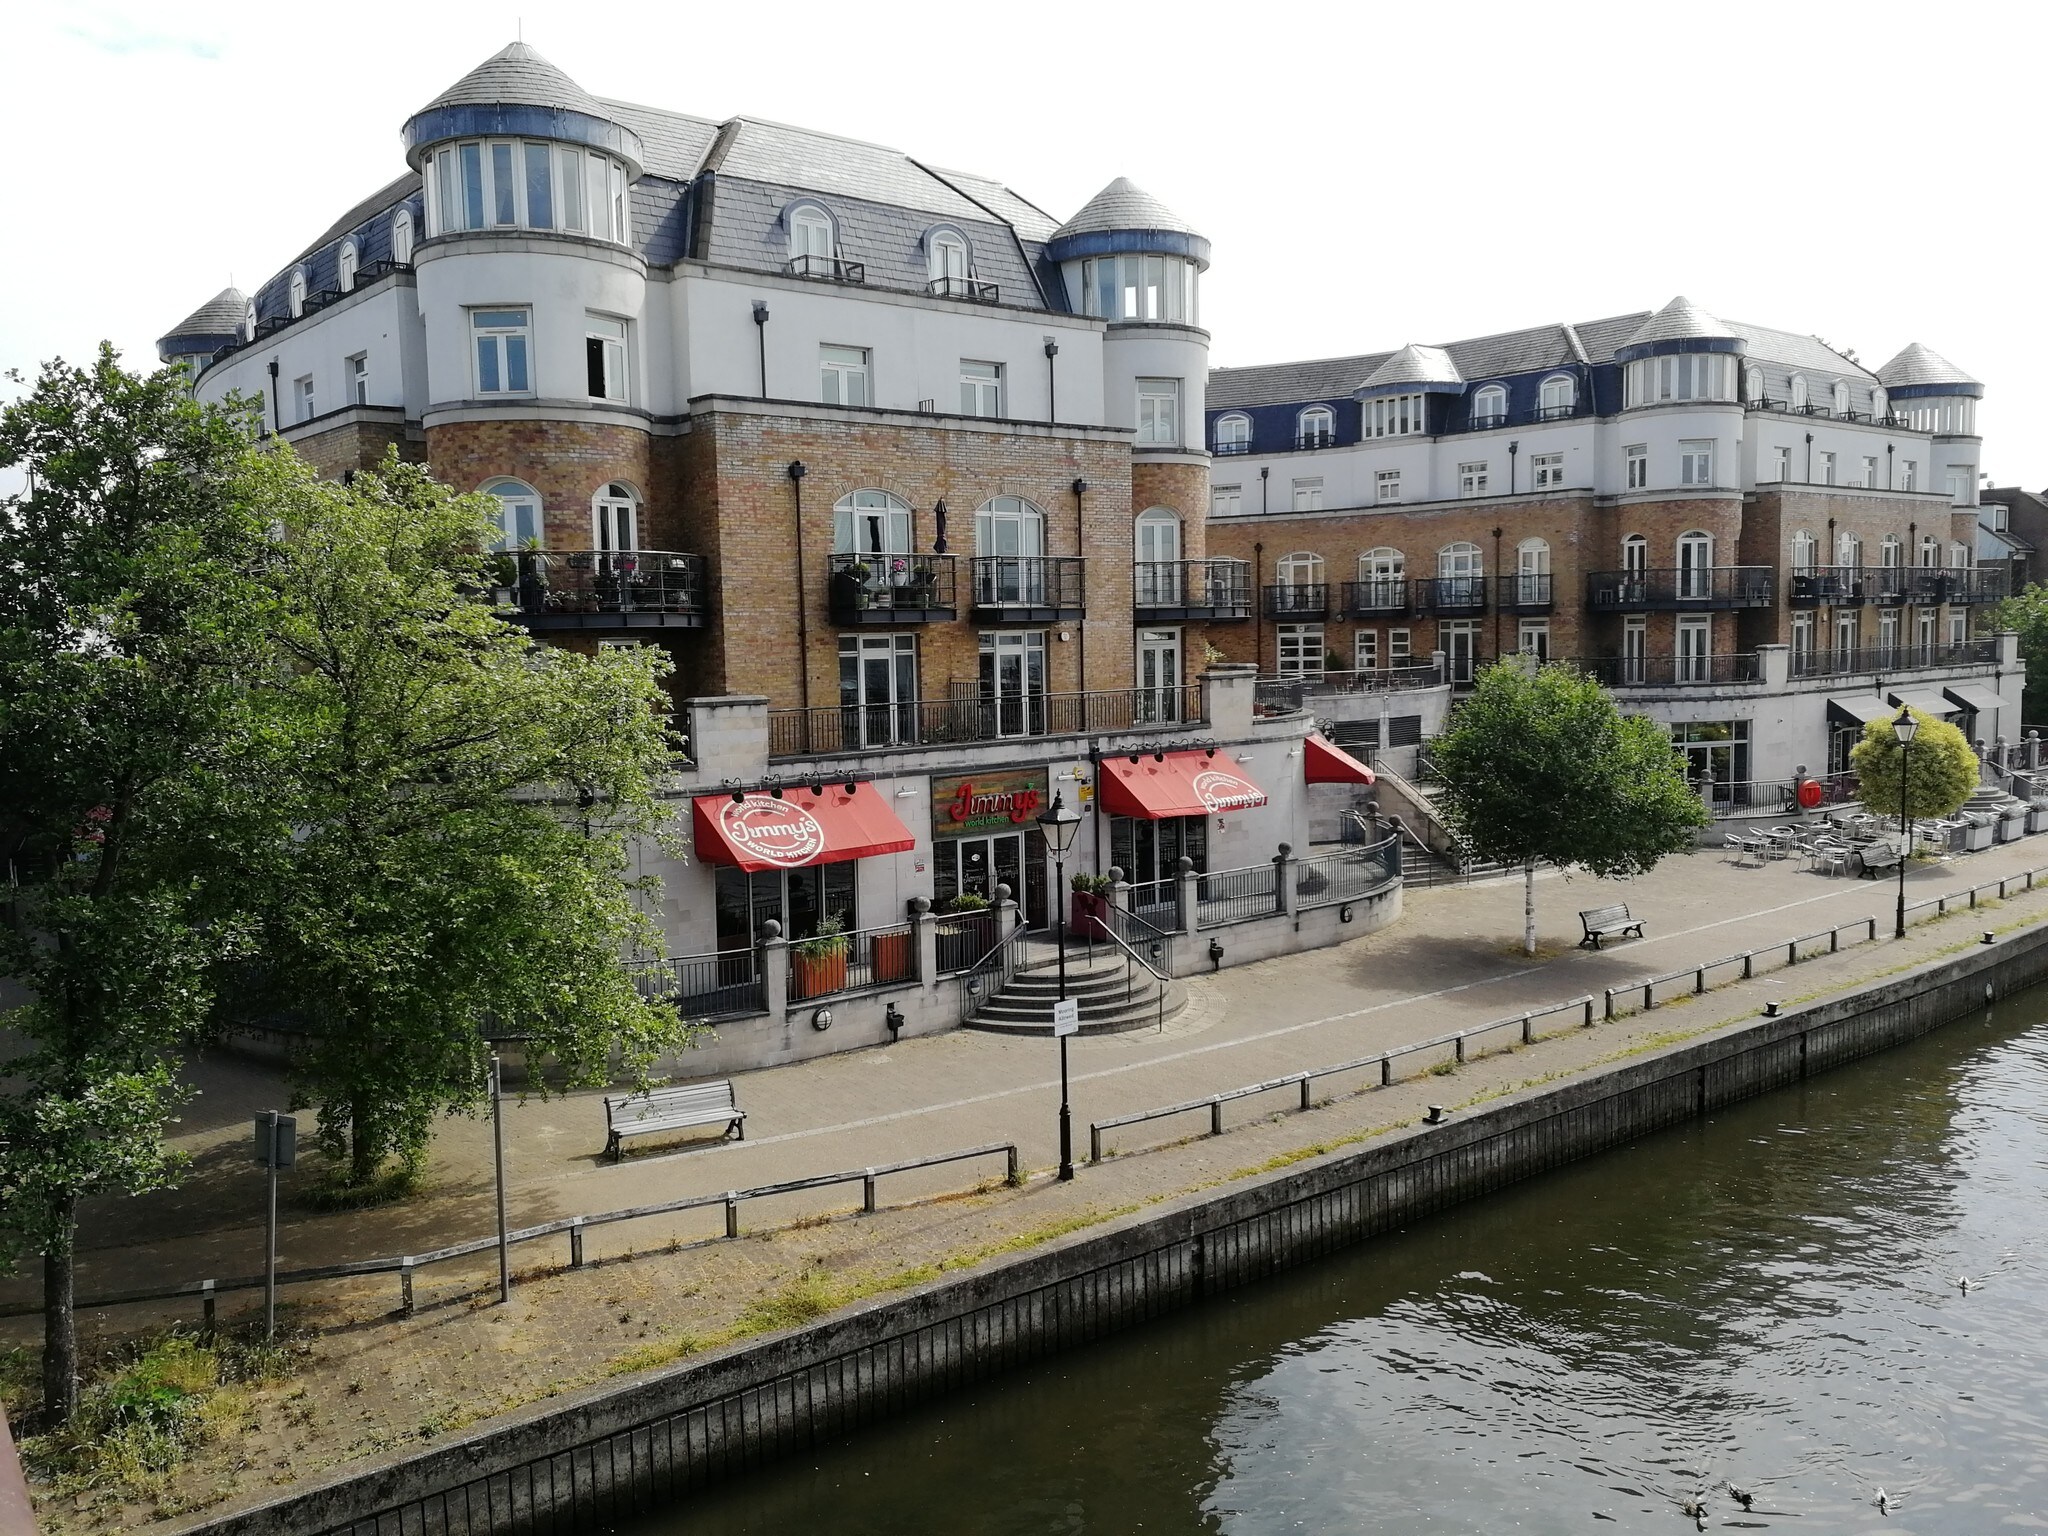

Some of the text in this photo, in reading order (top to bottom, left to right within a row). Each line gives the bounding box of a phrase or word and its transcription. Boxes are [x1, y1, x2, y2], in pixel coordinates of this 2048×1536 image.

[731, 800, 789, 817] world kitchen
[950, 782, 1039, 824] Jimmy's
[732, 816, 817, 841] Jimmy's
[965, 816, 1009, 828] world kitchen
[746, 837, 817, 859] WORLD KITCHEN
